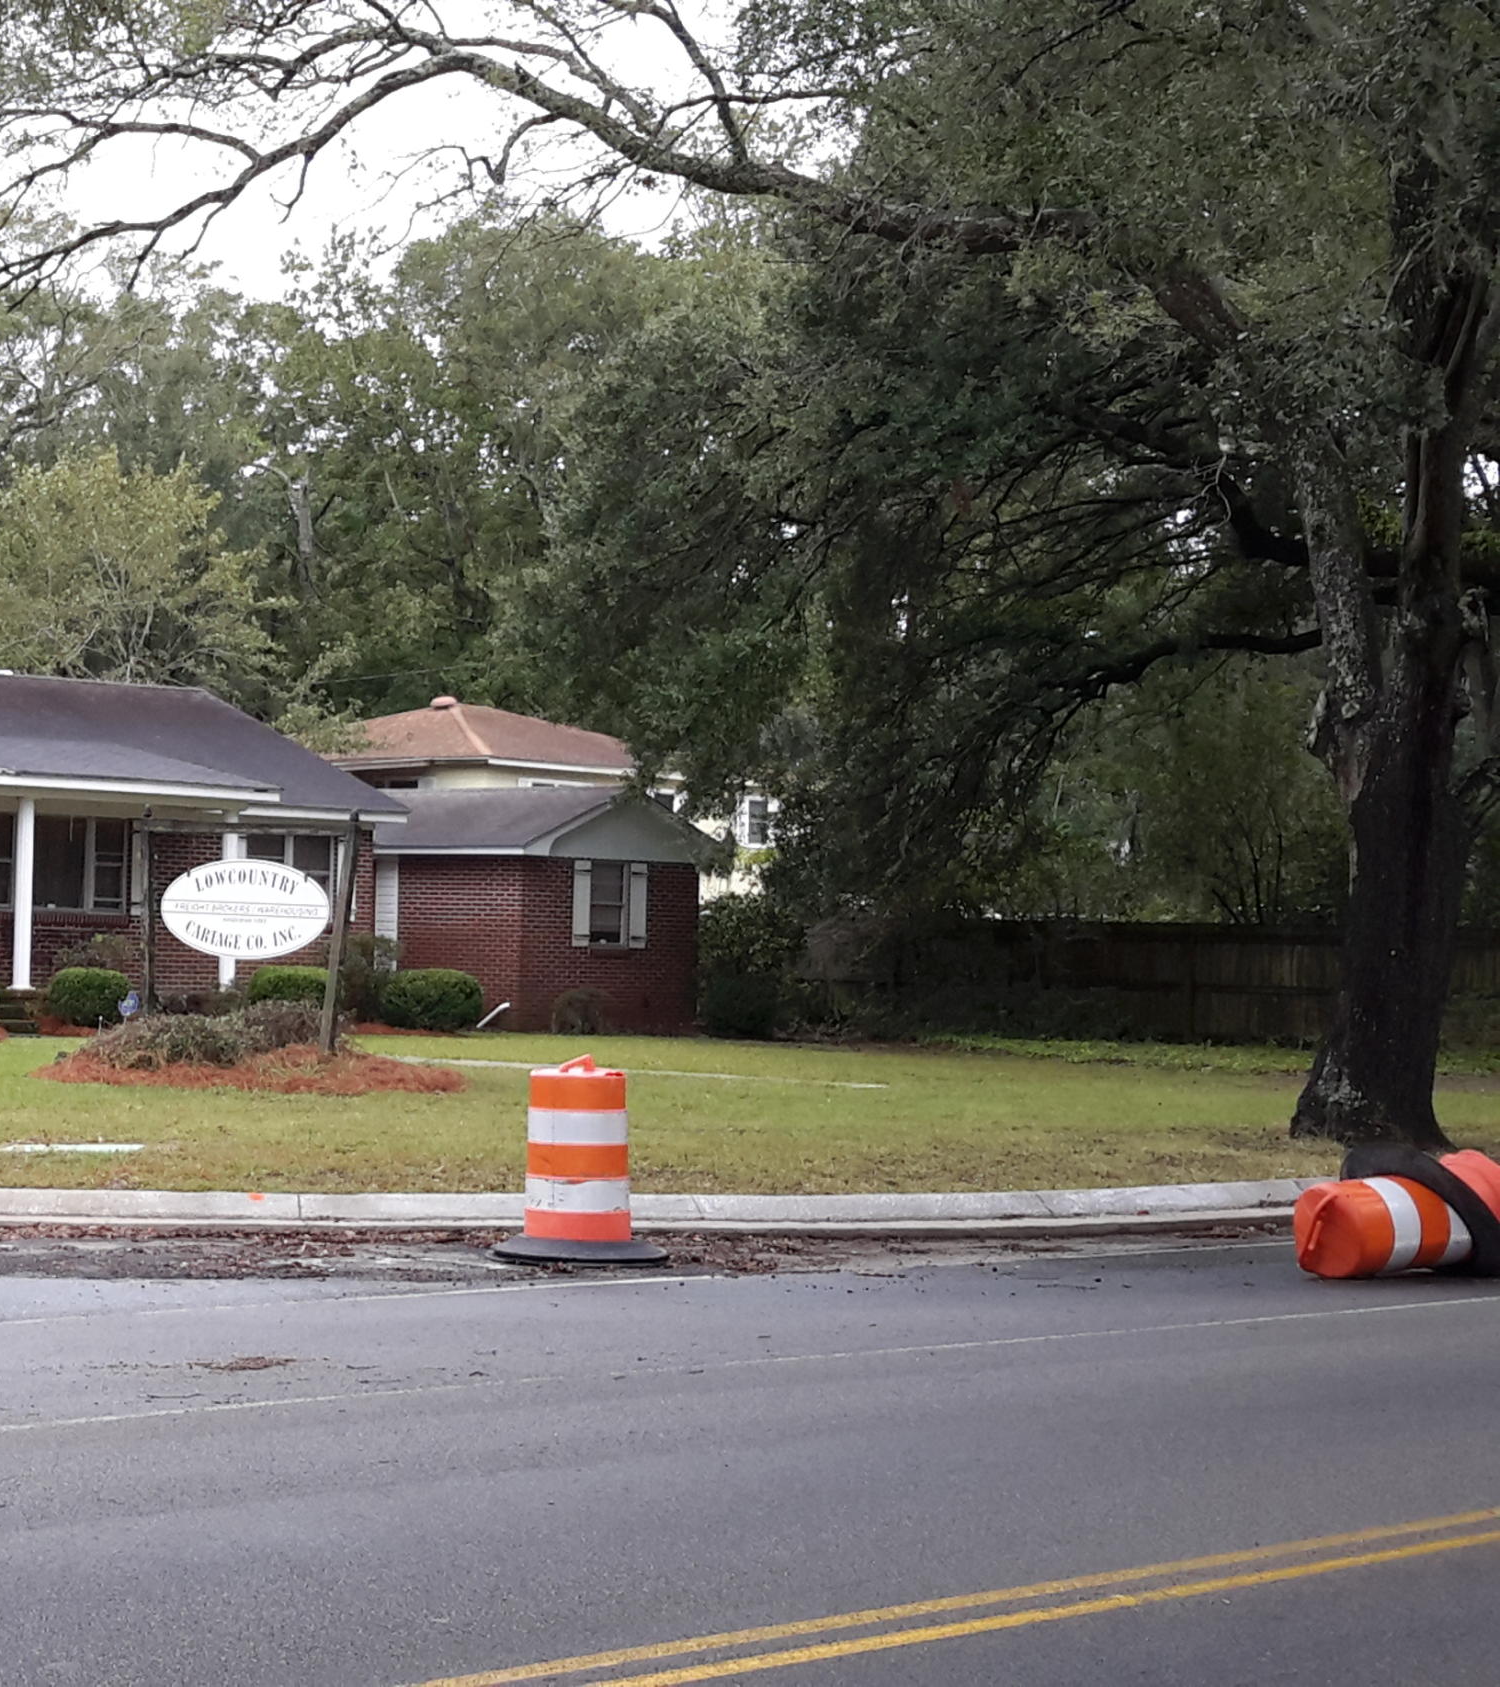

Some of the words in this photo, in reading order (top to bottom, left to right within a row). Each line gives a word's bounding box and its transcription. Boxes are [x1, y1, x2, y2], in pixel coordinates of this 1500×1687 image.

[194, 868, 299, 895] LOWCOUNTRY
[185, 919, 241, 950] CARTAGE
[246, 935, 268, 950] CO.
[272, 925, 302, 948] INC.
